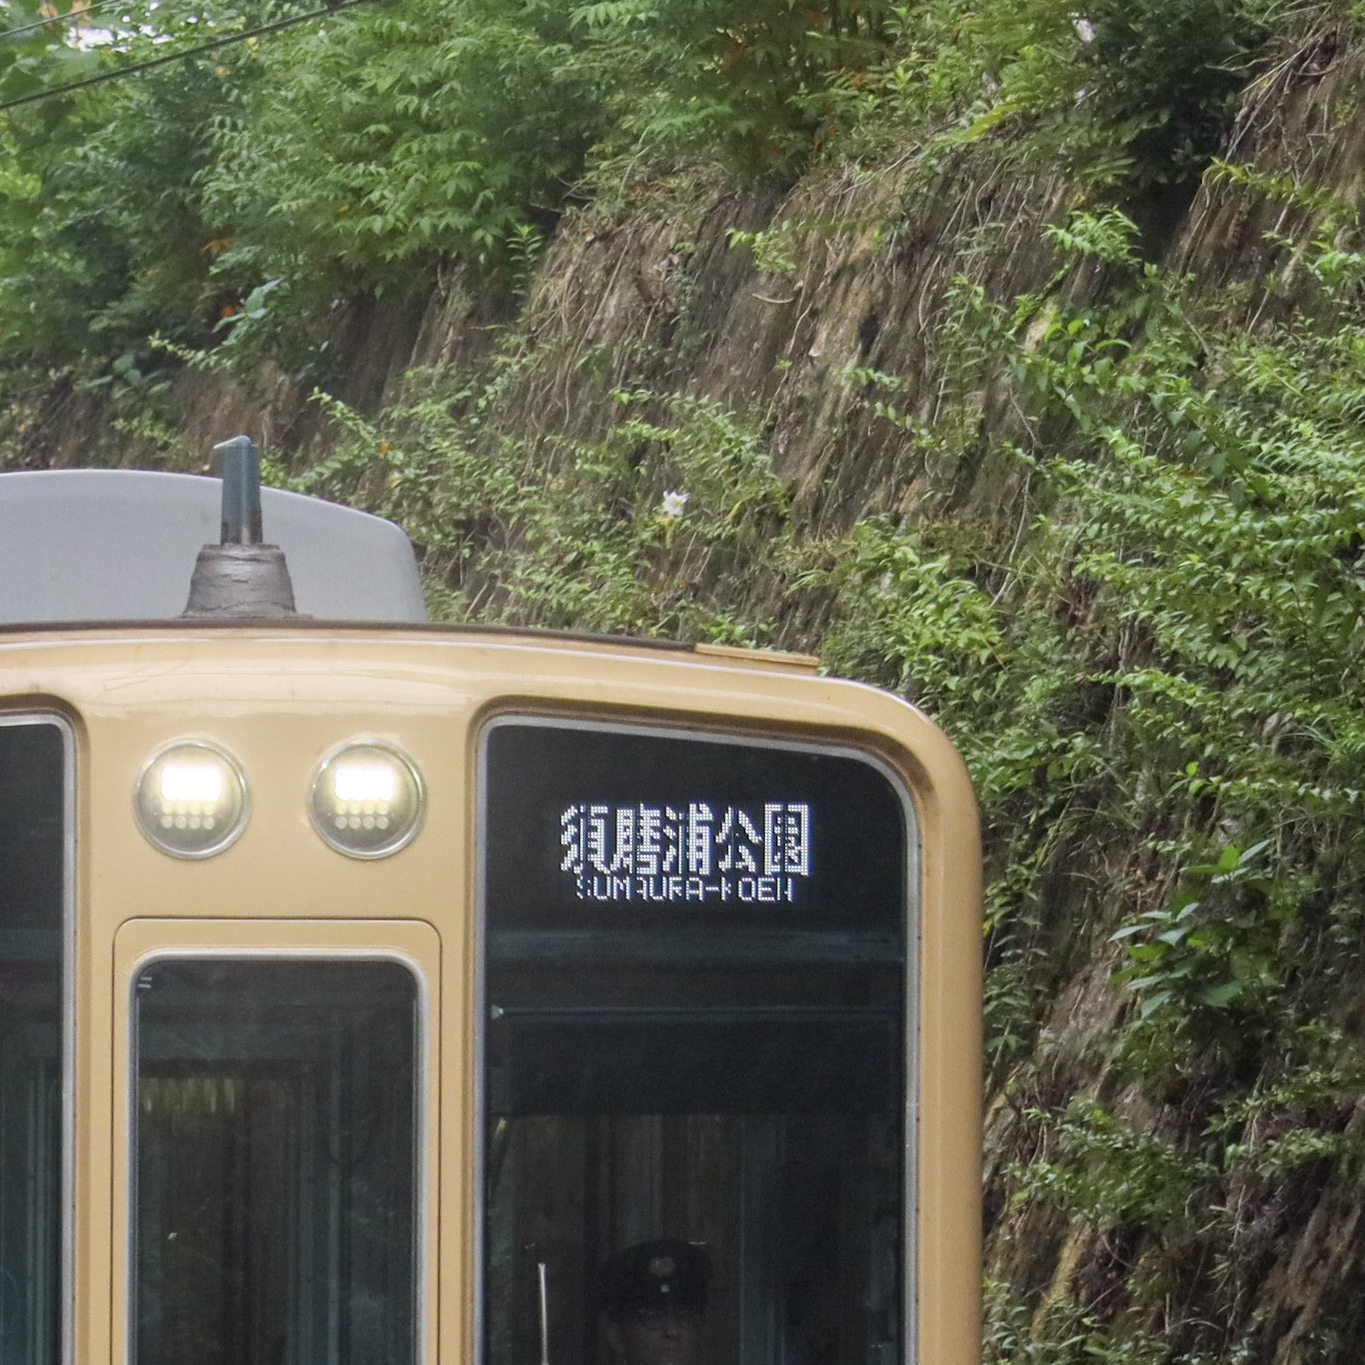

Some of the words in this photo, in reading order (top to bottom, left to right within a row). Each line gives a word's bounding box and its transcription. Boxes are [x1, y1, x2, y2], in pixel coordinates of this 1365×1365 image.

[560, 802, 810, 876] 須磨浦公園
